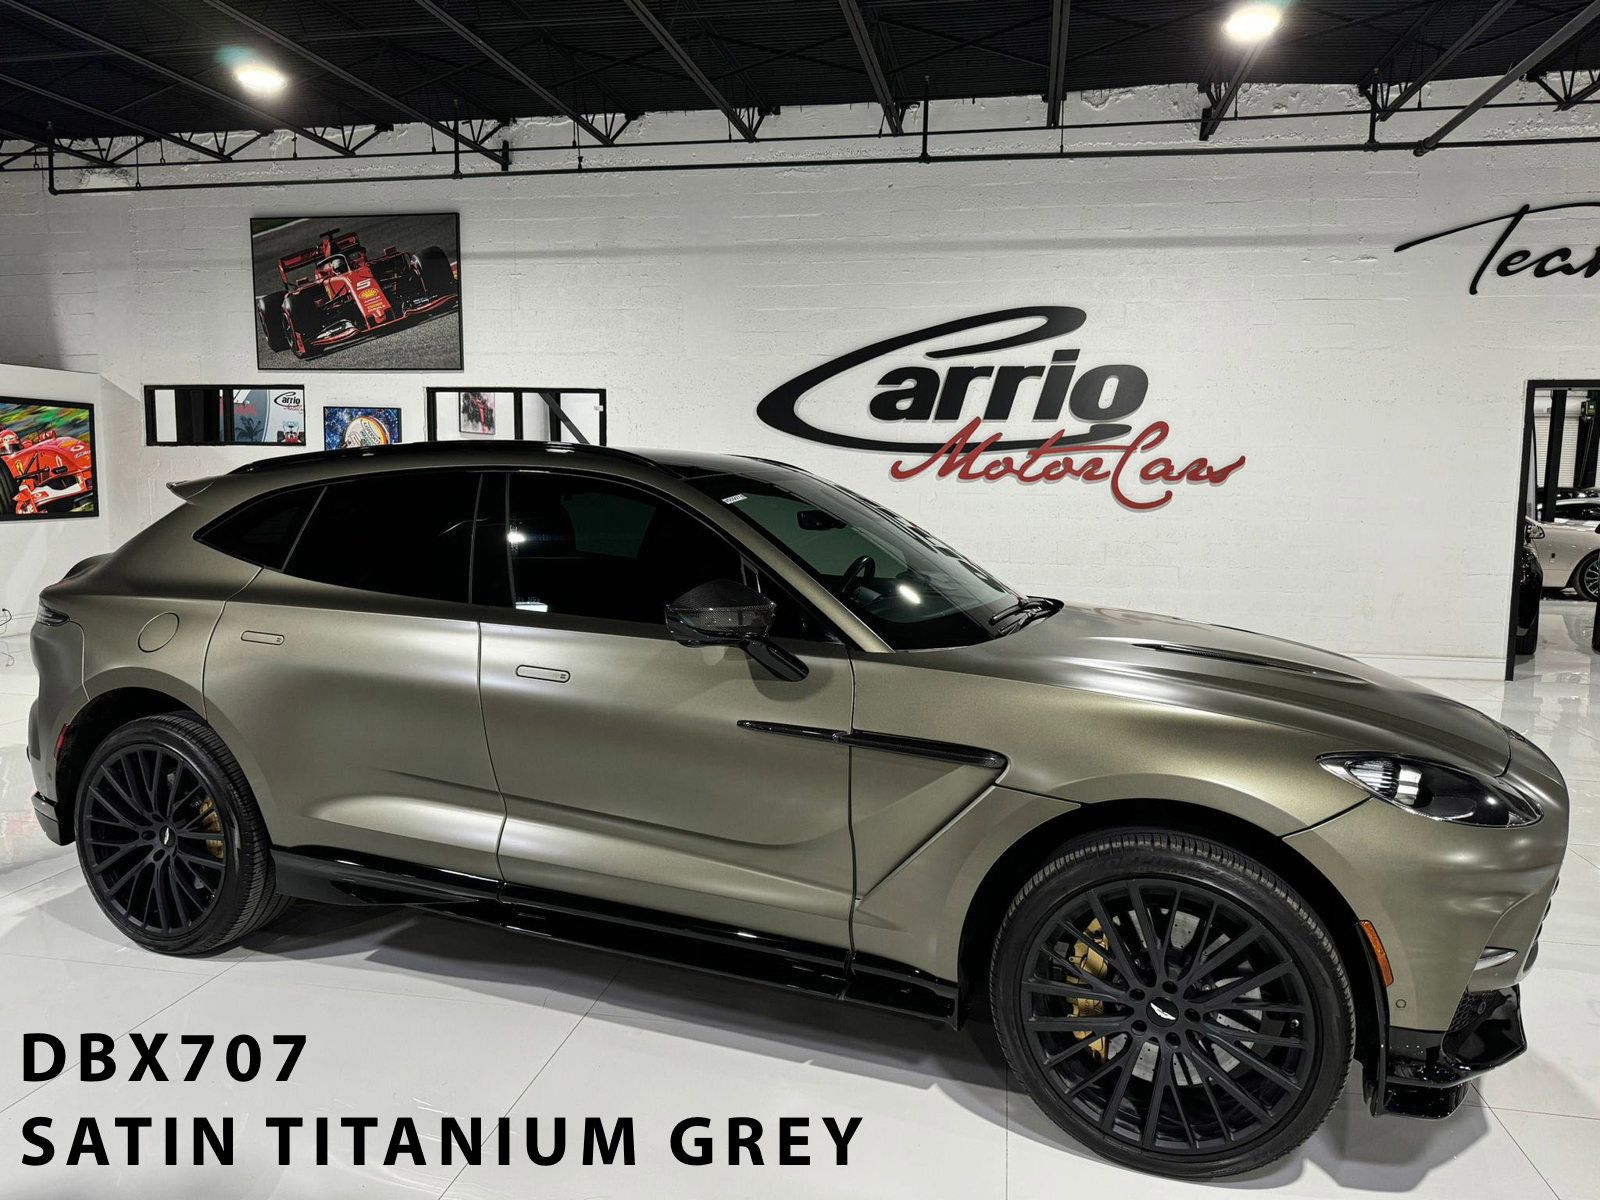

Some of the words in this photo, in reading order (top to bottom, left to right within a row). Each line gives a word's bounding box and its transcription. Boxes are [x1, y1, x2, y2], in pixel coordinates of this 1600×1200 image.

[1393, 201, 1600, 295] Tea
[356, 278, 371, 291] 5
[273, 391, 301, 408] Carrio
[755, 304, 1149, 454] Carrio
